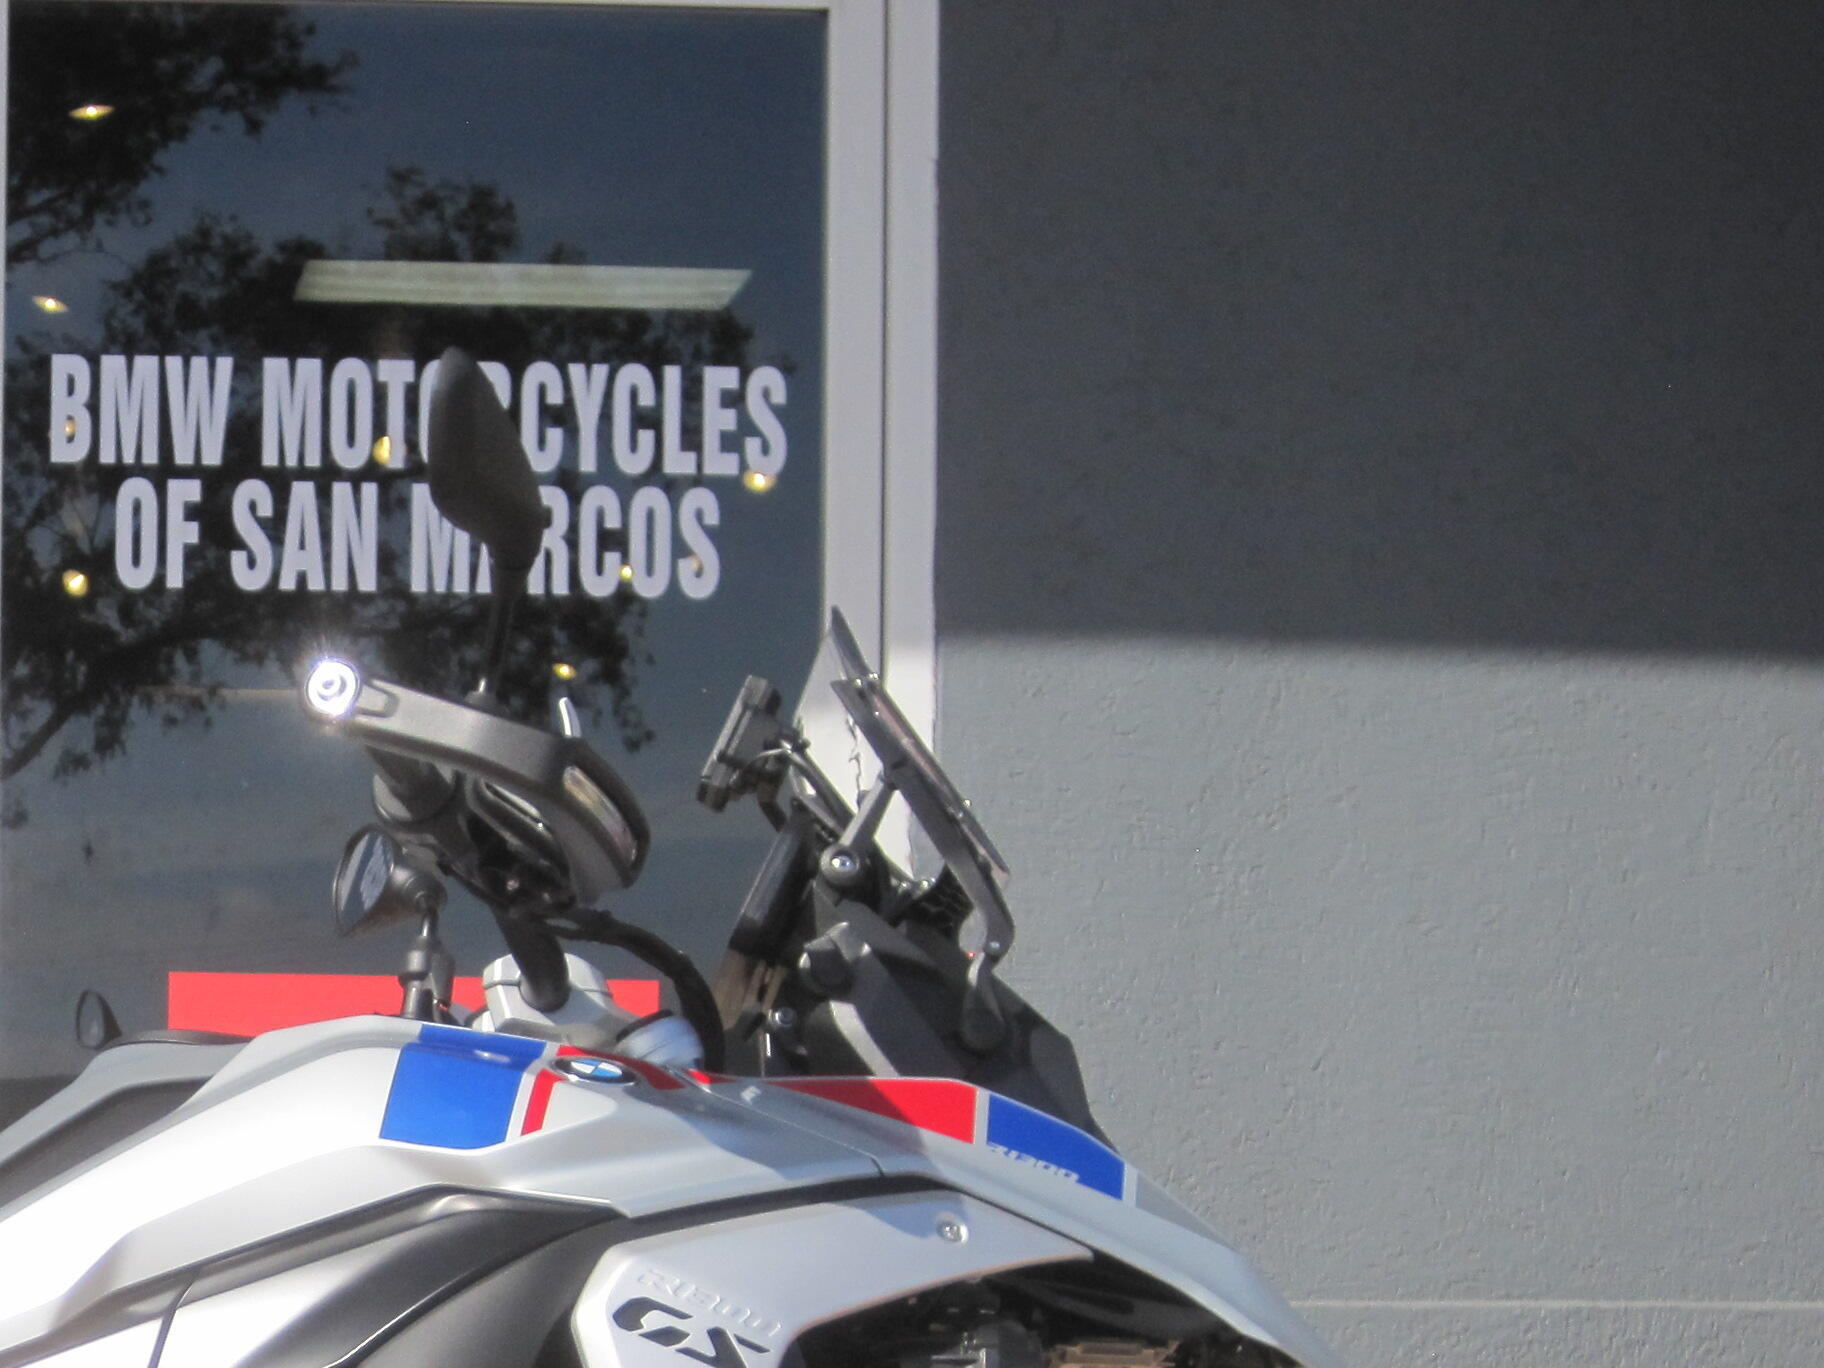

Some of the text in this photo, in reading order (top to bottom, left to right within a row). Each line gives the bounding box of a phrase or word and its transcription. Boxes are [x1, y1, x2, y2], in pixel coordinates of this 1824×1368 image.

[49, 353, 788, 475] BMW MOTCYCLES
[114, 477, 721, 599] OF SAN MRCOS
